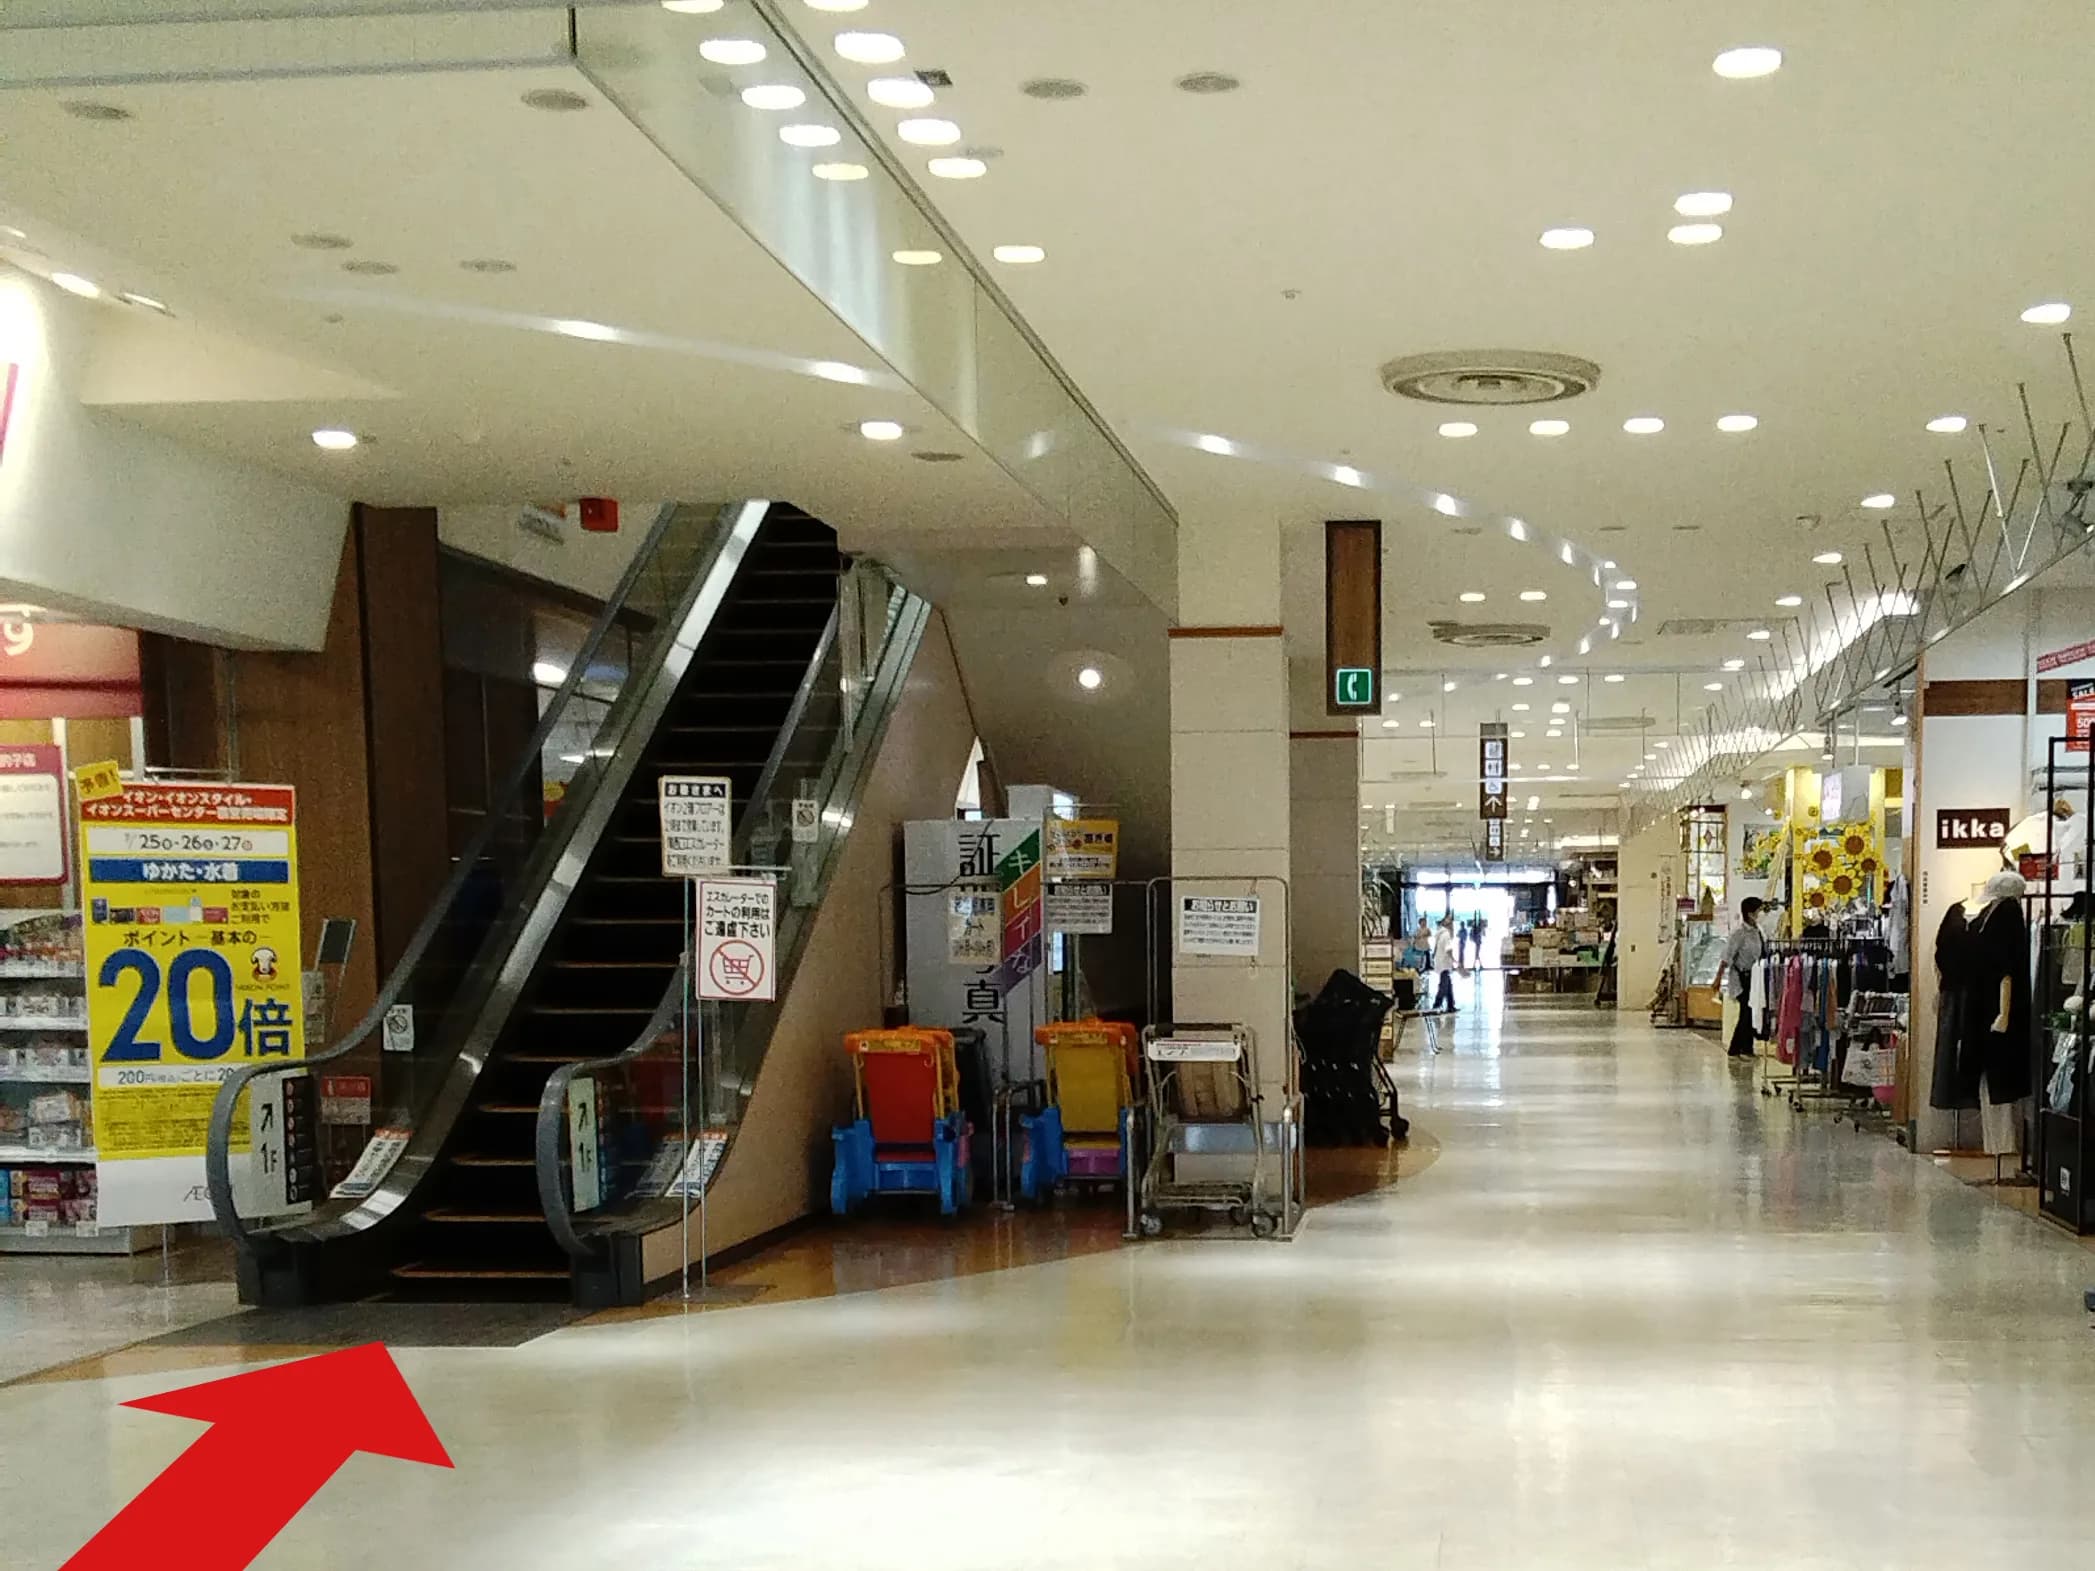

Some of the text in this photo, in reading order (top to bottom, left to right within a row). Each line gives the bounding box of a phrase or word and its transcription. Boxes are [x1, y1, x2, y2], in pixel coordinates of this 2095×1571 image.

[1941, 817, 2004, 839] ikka
[705, 905, 770, 921] カートの利用は
[123, 929, 191, 947] ポイント
[704, 920, 770, 939] ご遠慮下さい
